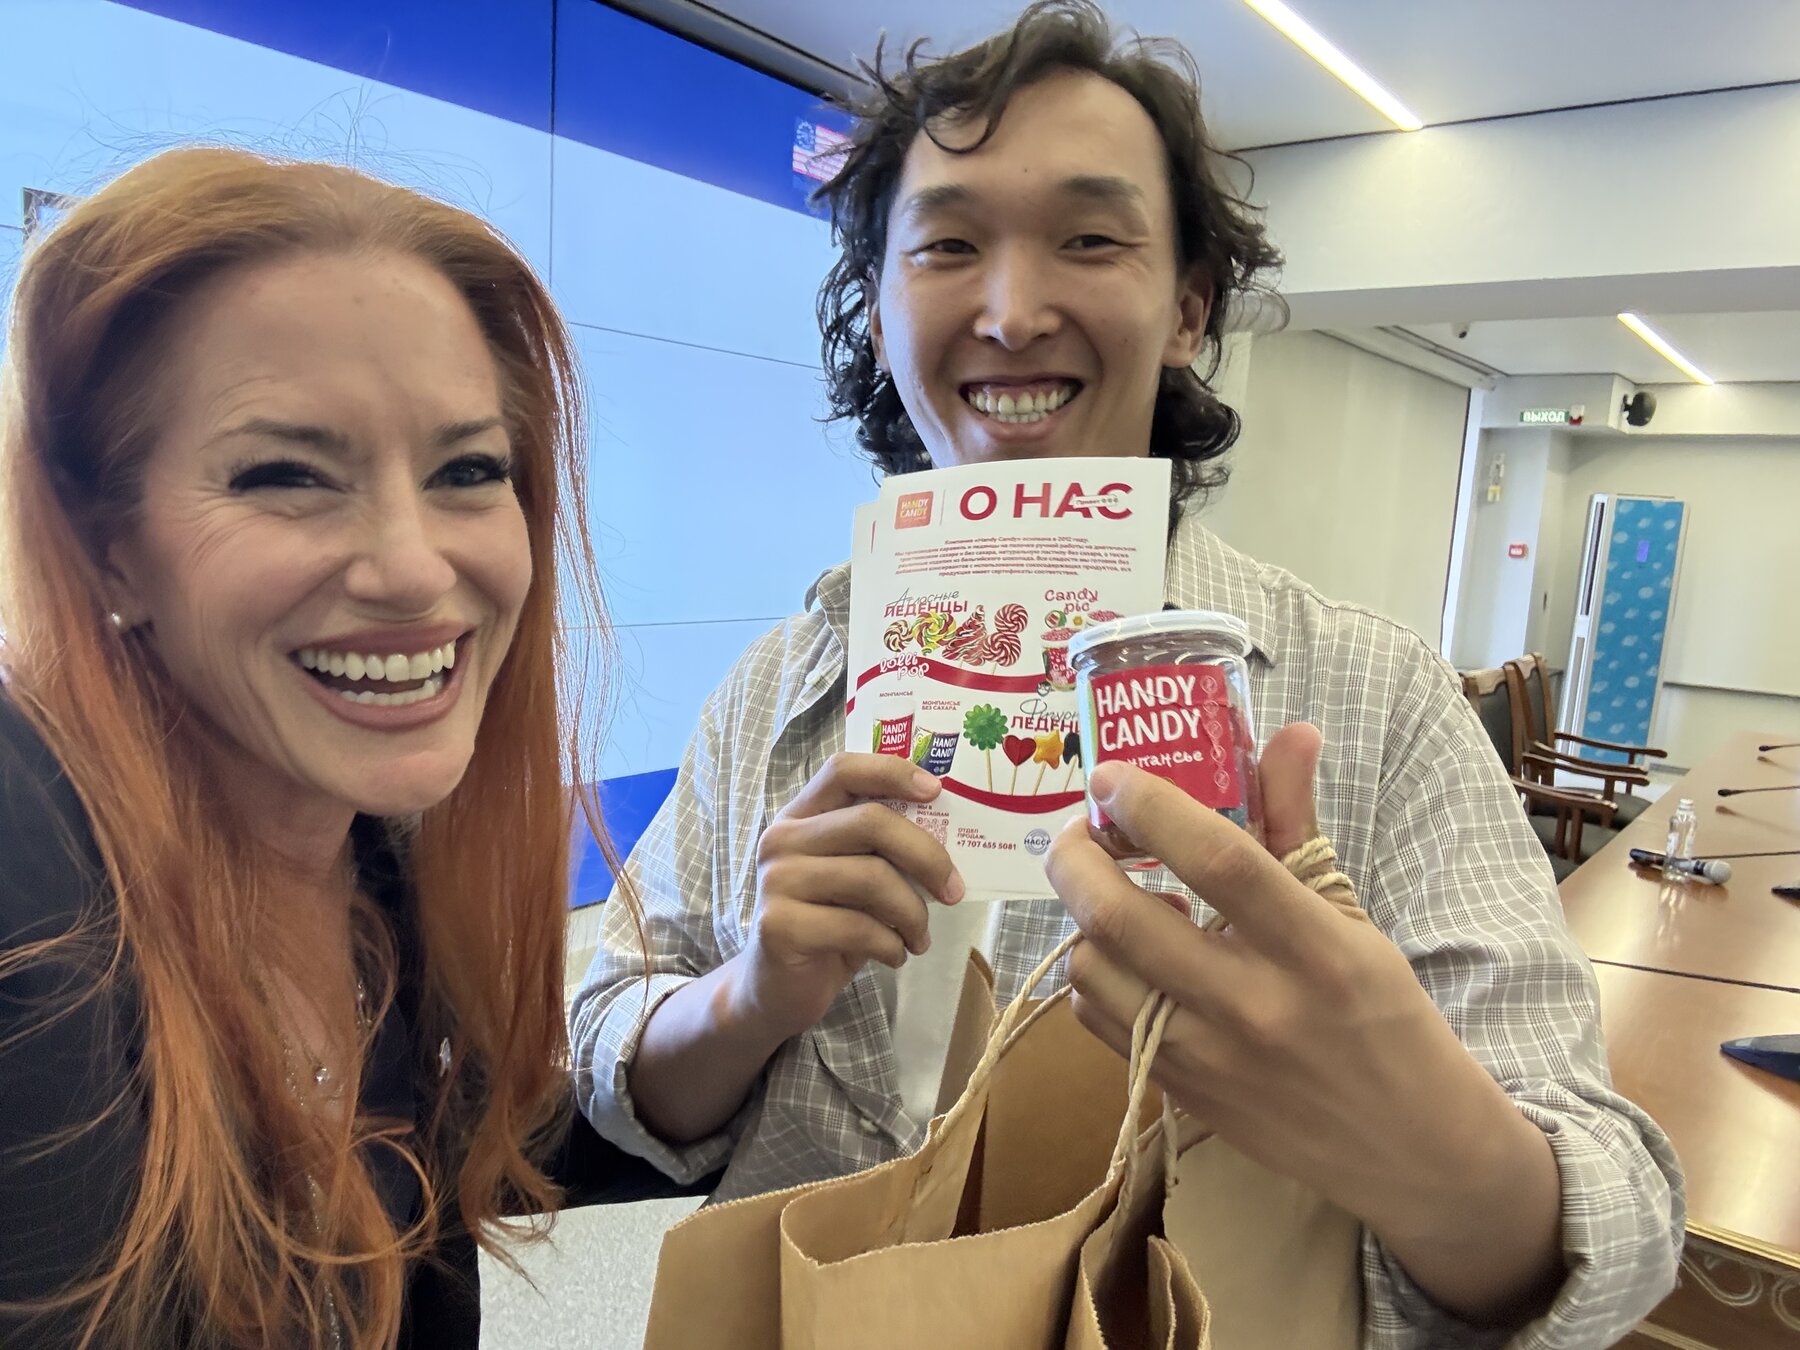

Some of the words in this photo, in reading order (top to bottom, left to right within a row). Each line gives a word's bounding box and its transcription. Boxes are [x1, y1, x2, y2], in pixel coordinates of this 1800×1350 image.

[1523, 411, 1566, 423] ВЫХОД
[959, 485, 998, 521] О
[1012, 482, 1134, 520] НАС
[1044, 588, 1099, 603] Candy
[879, 651, 918, 673] lolli
[896, 663, 930, 680] pop
[1096, 674, 1196, 718] HANDY
[882, 721, 908, 734] HANDY
[1100, 709, 1201, 752] CANDY
[881, 732, 907, 745] CANDY
[998, 842, 1018, 850] 5081
[1023, 838, 1052, 846] HACCP
